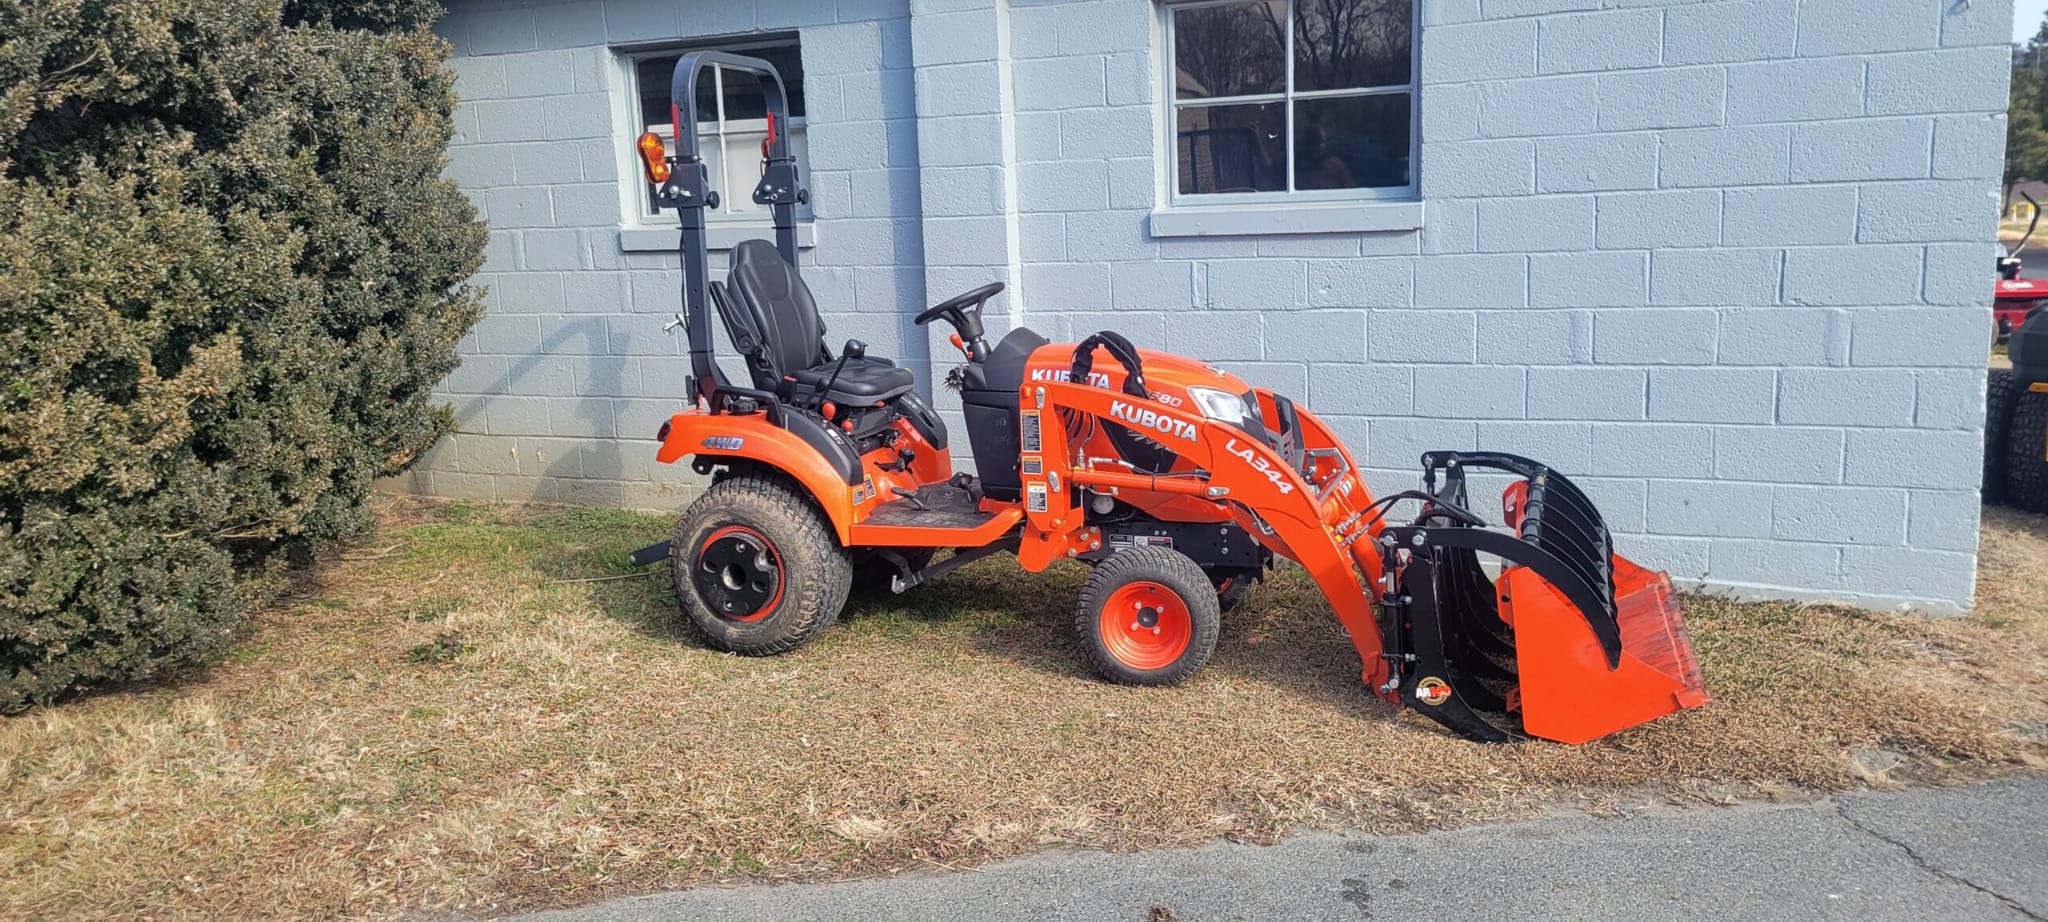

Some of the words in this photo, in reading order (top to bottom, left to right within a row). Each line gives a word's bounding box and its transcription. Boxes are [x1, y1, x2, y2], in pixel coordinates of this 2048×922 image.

[1031, 369, 1110, 390] KUBTA
[1109, 400, 1198, 443] KUBOTA
[701, 436, 745, 450] 4WD
[1225, 438, 1294, 495] LA344
